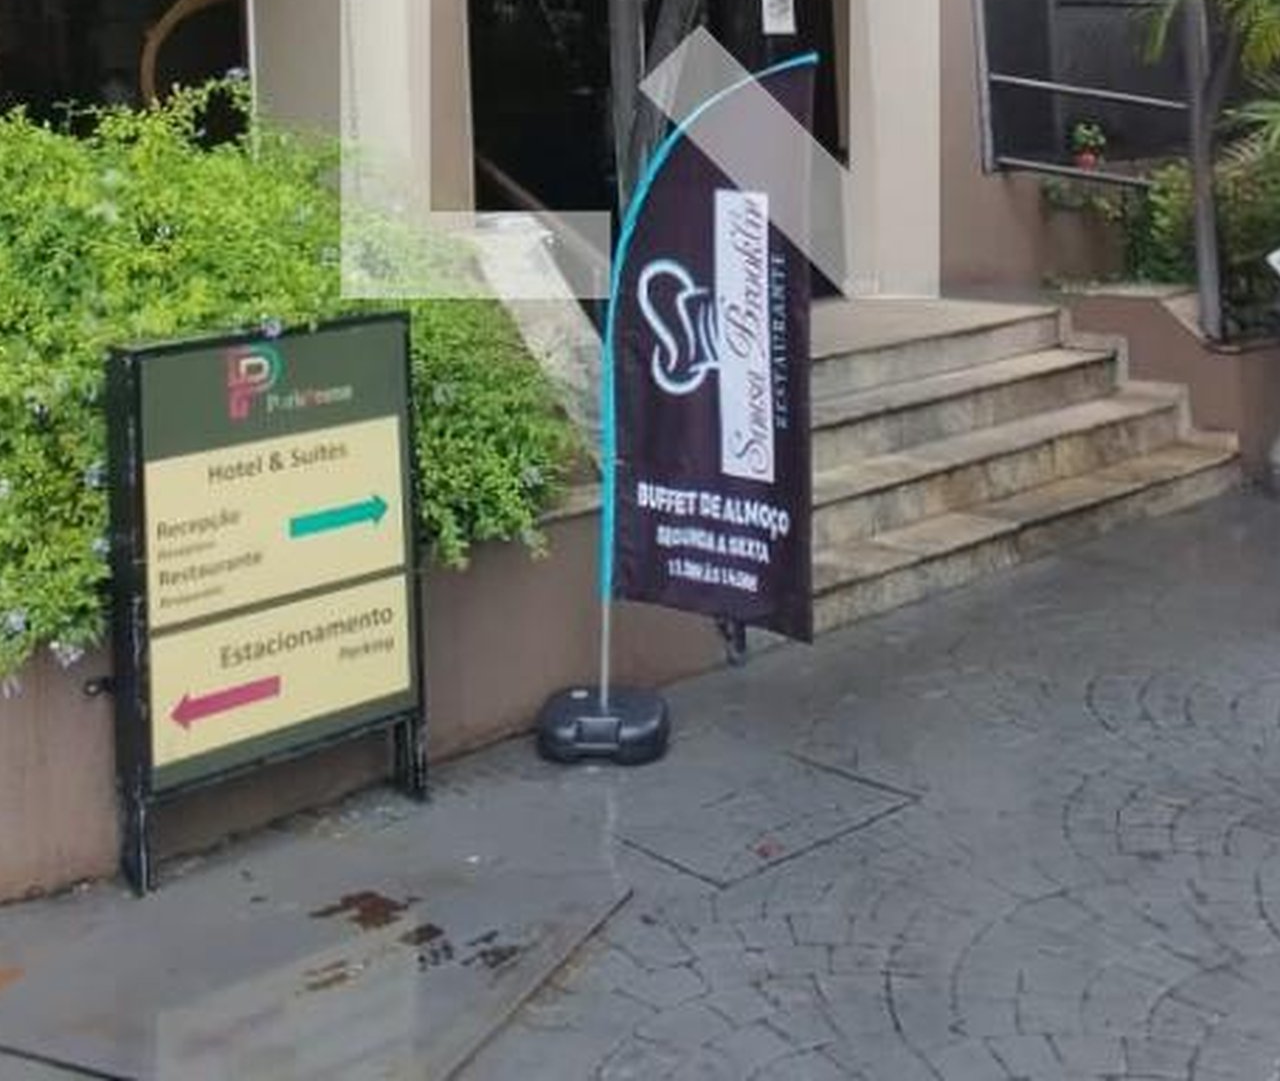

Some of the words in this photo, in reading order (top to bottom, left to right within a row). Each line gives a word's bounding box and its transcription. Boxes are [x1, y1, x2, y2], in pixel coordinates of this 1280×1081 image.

[207, 455, 263, 487] Hotel
[268, 450, 285, 472] &
[290, 441, 349, 469] Suites
[637, 481, 698, 516] BUFFET
[699, 491, 721, 519] DE
[722, 497, 791, 541] ALMOÇO
[655, 524, 715, 553] SEGUNDA
[716, 534, 728, 554] A
[727, 535, 770, 564] SEXTA
[159, 550, 263, 587] Restaurante
[220, 607, 394, 669] Estacionamento
